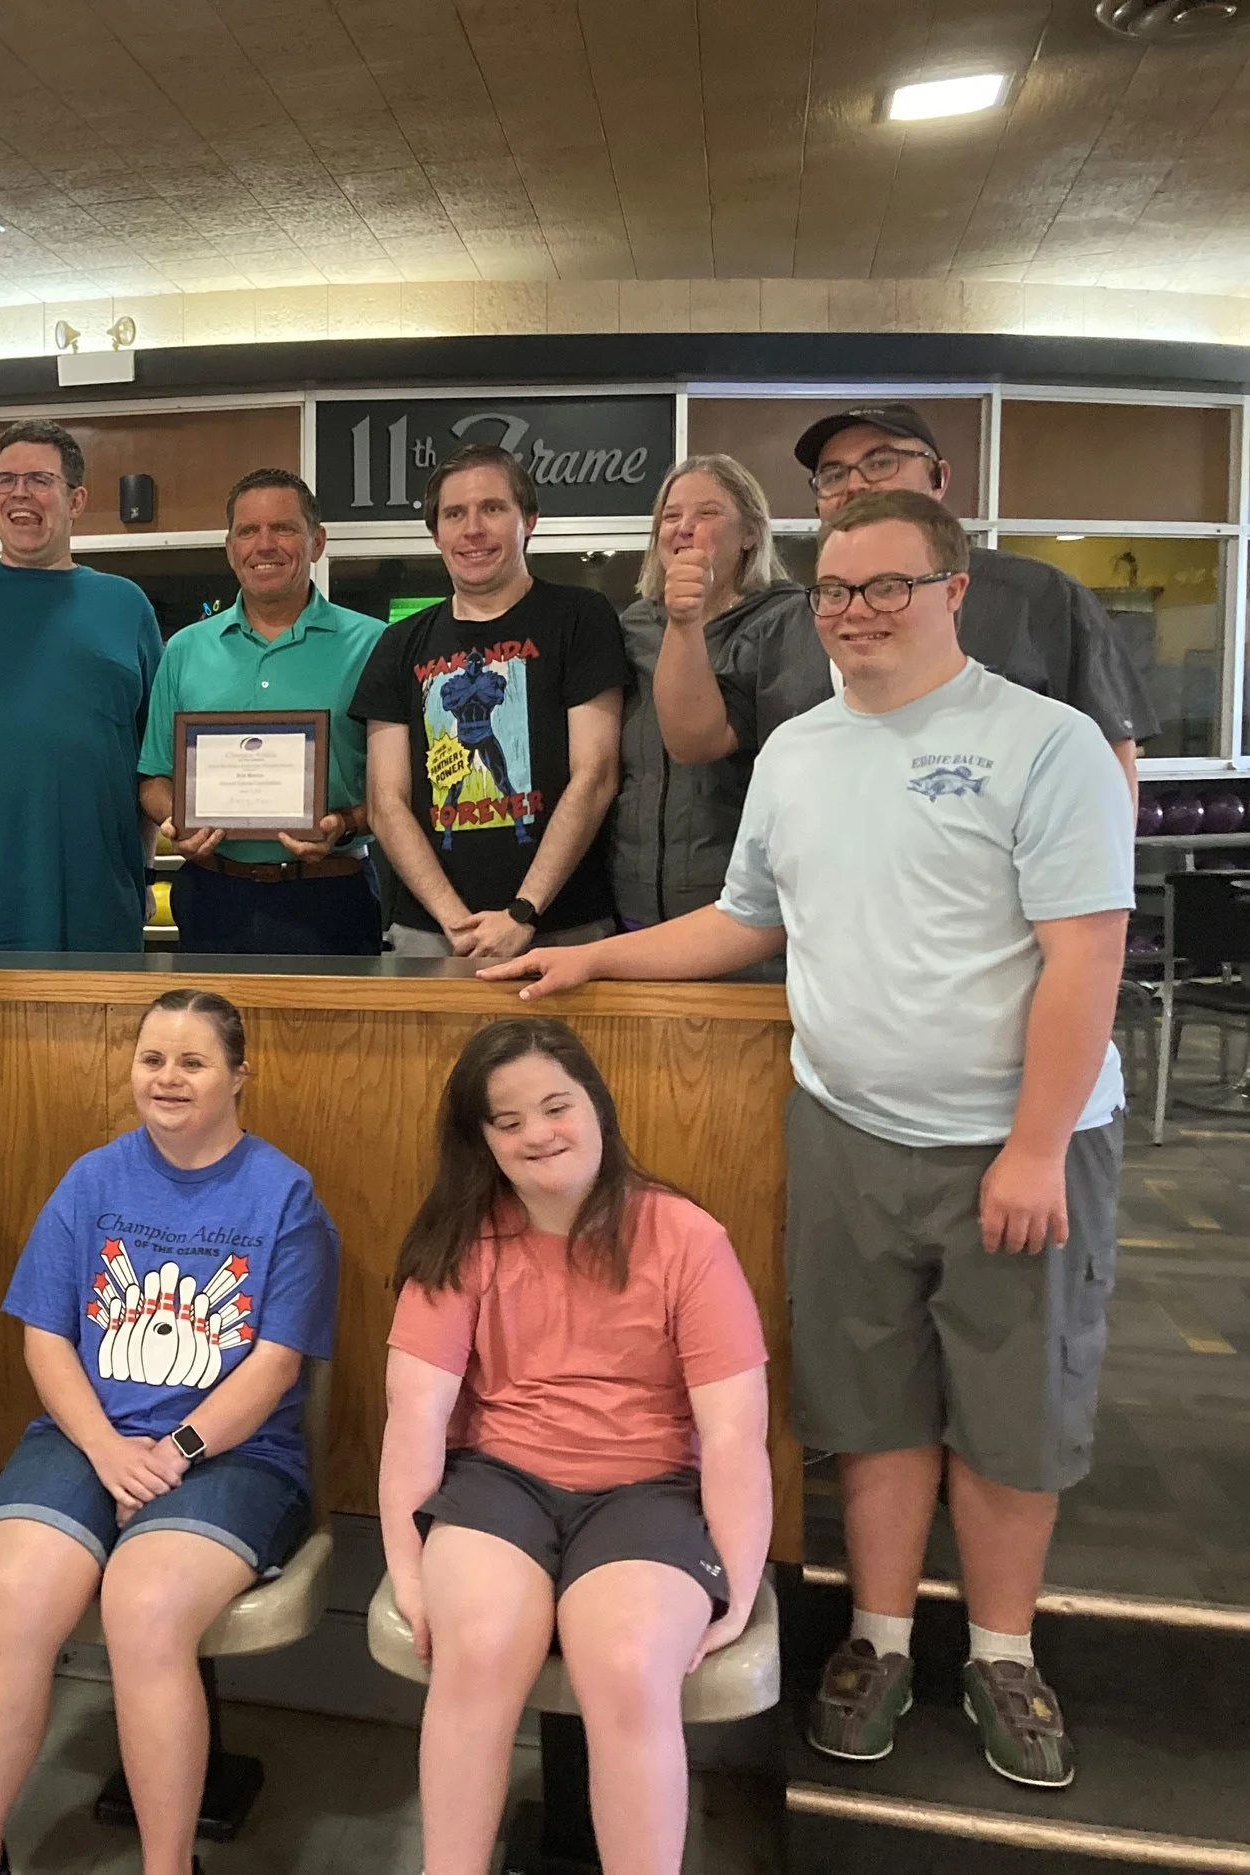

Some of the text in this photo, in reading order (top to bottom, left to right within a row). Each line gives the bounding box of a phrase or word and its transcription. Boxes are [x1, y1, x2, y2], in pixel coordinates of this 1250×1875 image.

[435, 760, 465, 784] POWER
[911, 754, 951, 769] EDDIE
[430, 790, 544, 828] FOREVER
[96, 1212, 264, 1248] Champion Athletes
[134, 1239, 221, 1257] OF THE OZARKS
